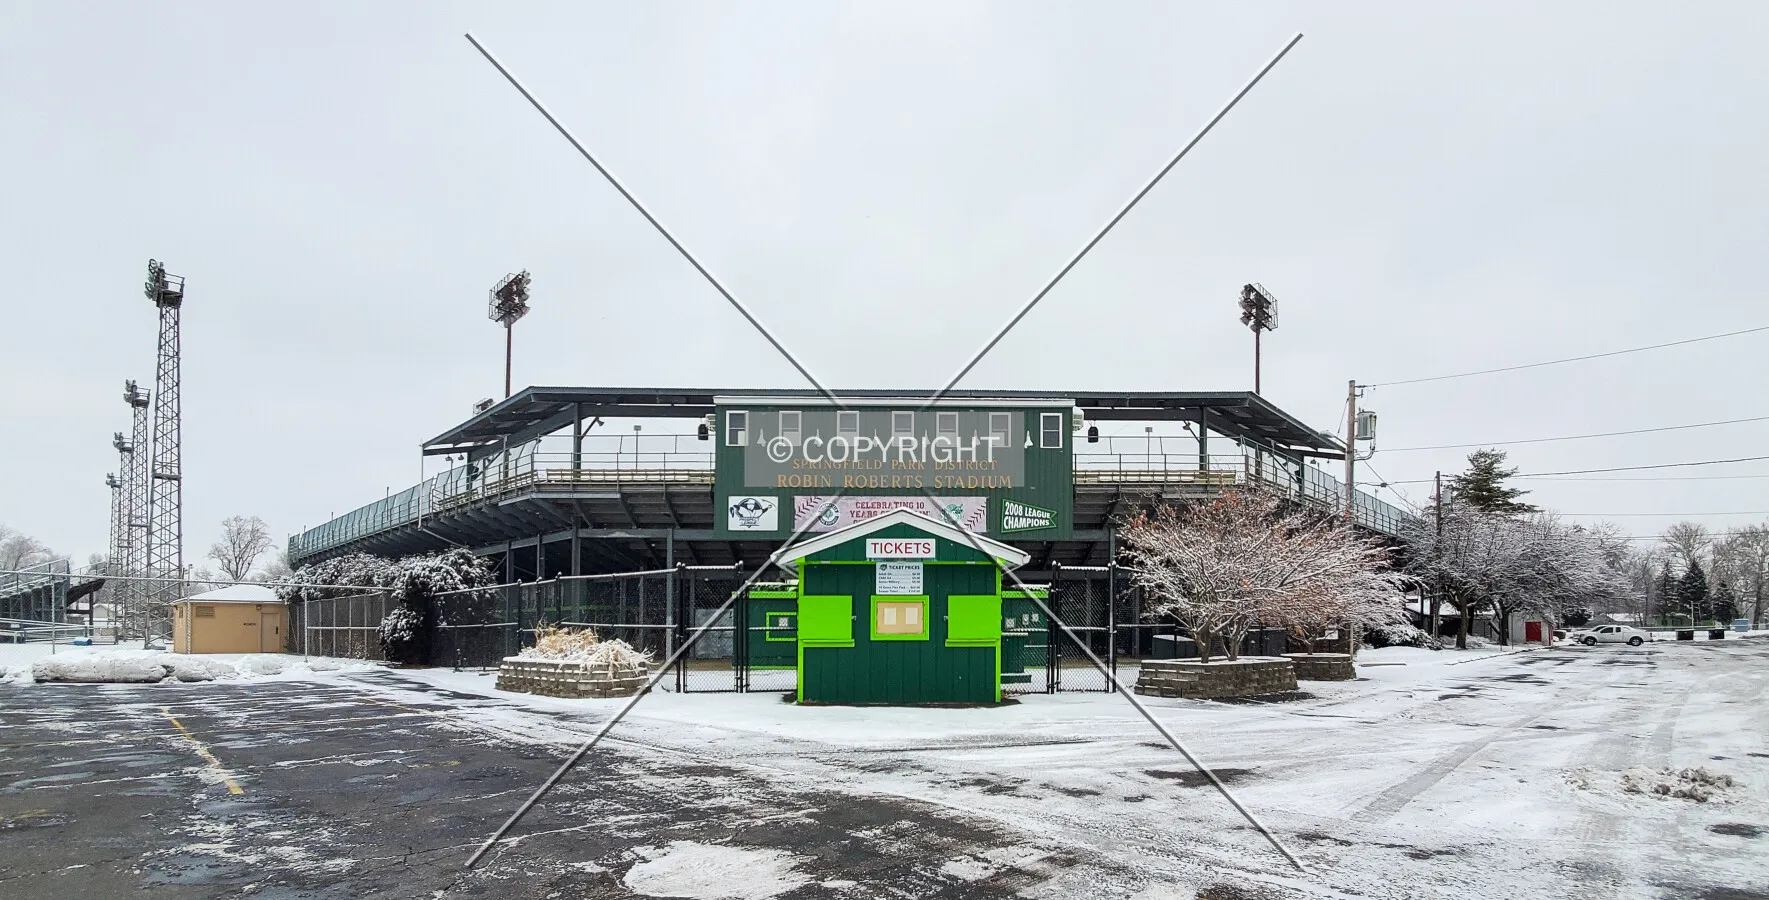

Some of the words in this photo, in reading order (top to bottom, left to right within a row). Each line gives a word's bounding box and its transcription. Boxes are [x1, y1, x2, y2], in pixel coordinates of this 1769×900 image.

[792, 459, 883, 470] SPRINGFIELD
[891, 460, 925, 470] PARK
[935, 460, 997, 471] DISTRICT
[777, 474, 832, 488] ROBIN
[844, 474, 923, 489] ROBERTS
[935, 475, 1012, 489] STADIUM
[855, 501, 914, 509] CELEBRATING
[1004, 501, 1023, 516] 2008
[1024, 507, 1051, 519] LEAGUE
[1003, 516, 1050, 530] CHAMPIONS
[871, 542, 931, 555] TICKETS
